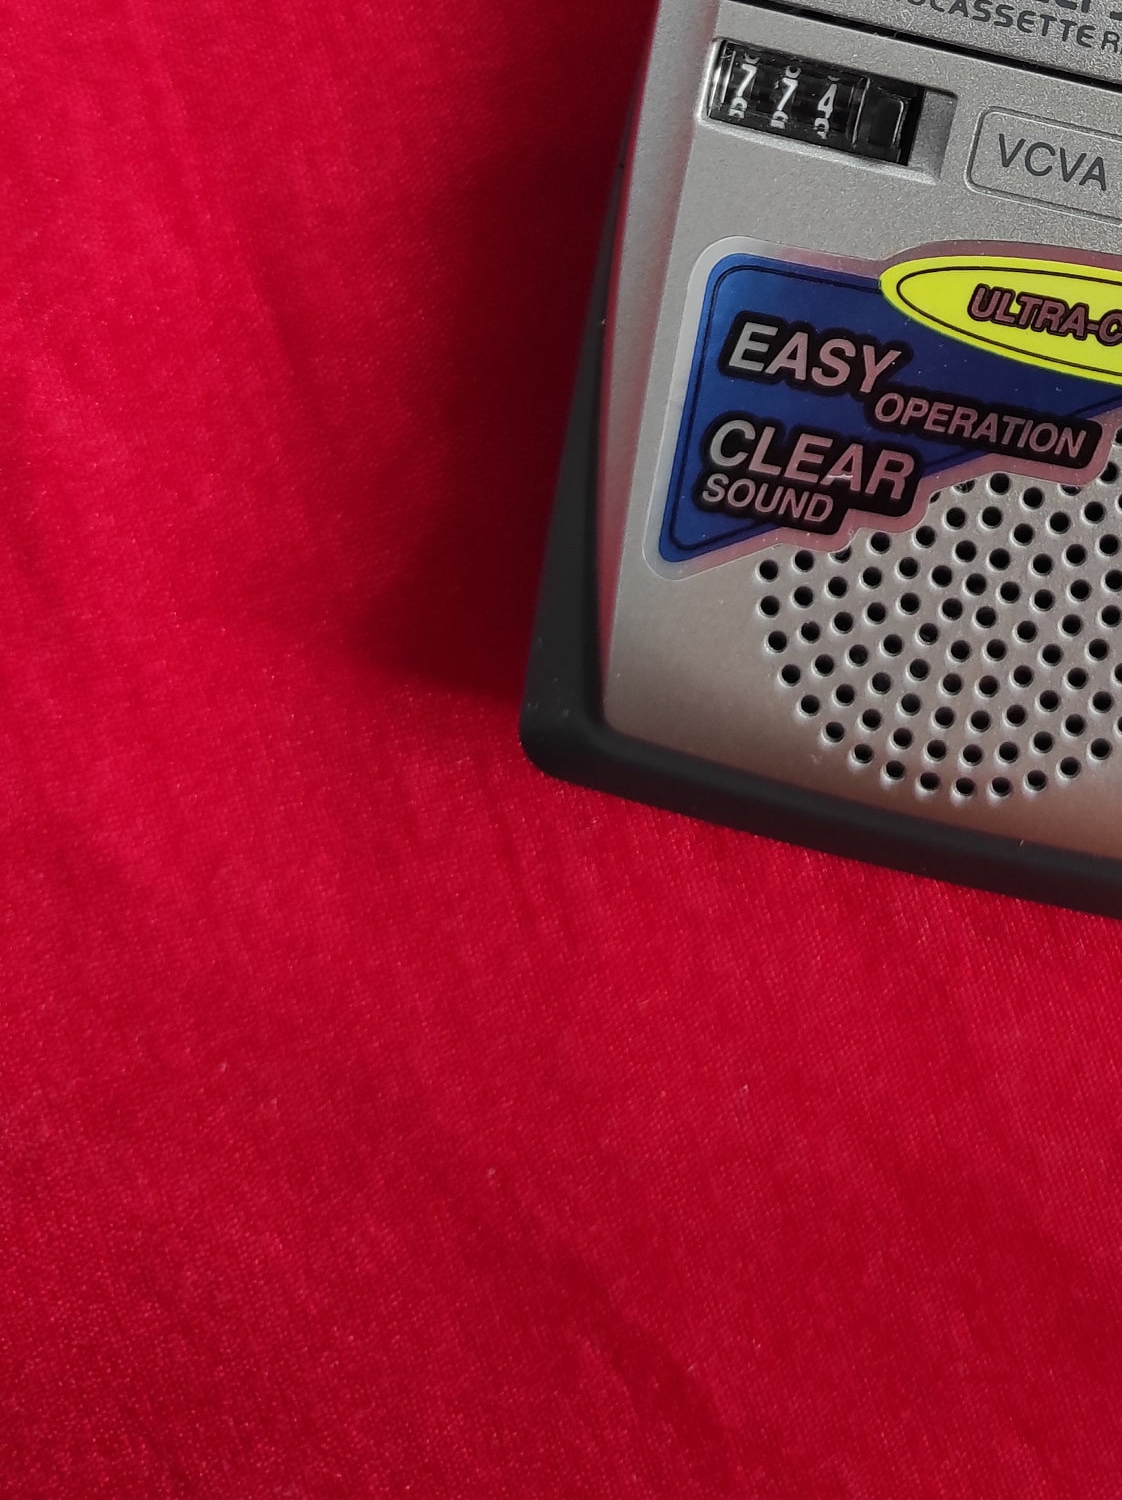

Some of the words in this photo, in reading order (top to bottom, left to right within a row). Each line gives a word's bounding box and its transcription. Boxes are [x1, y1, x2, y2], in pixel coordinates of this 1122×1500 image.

[998, 133, 1107, 191] VCVA
[729, 321, 901, 393] EASY
[874, 393, 1088, 458] OPERATION
[709, 419, 915, 500] CLEAR
[702, 474, 834, 523] SOUND
